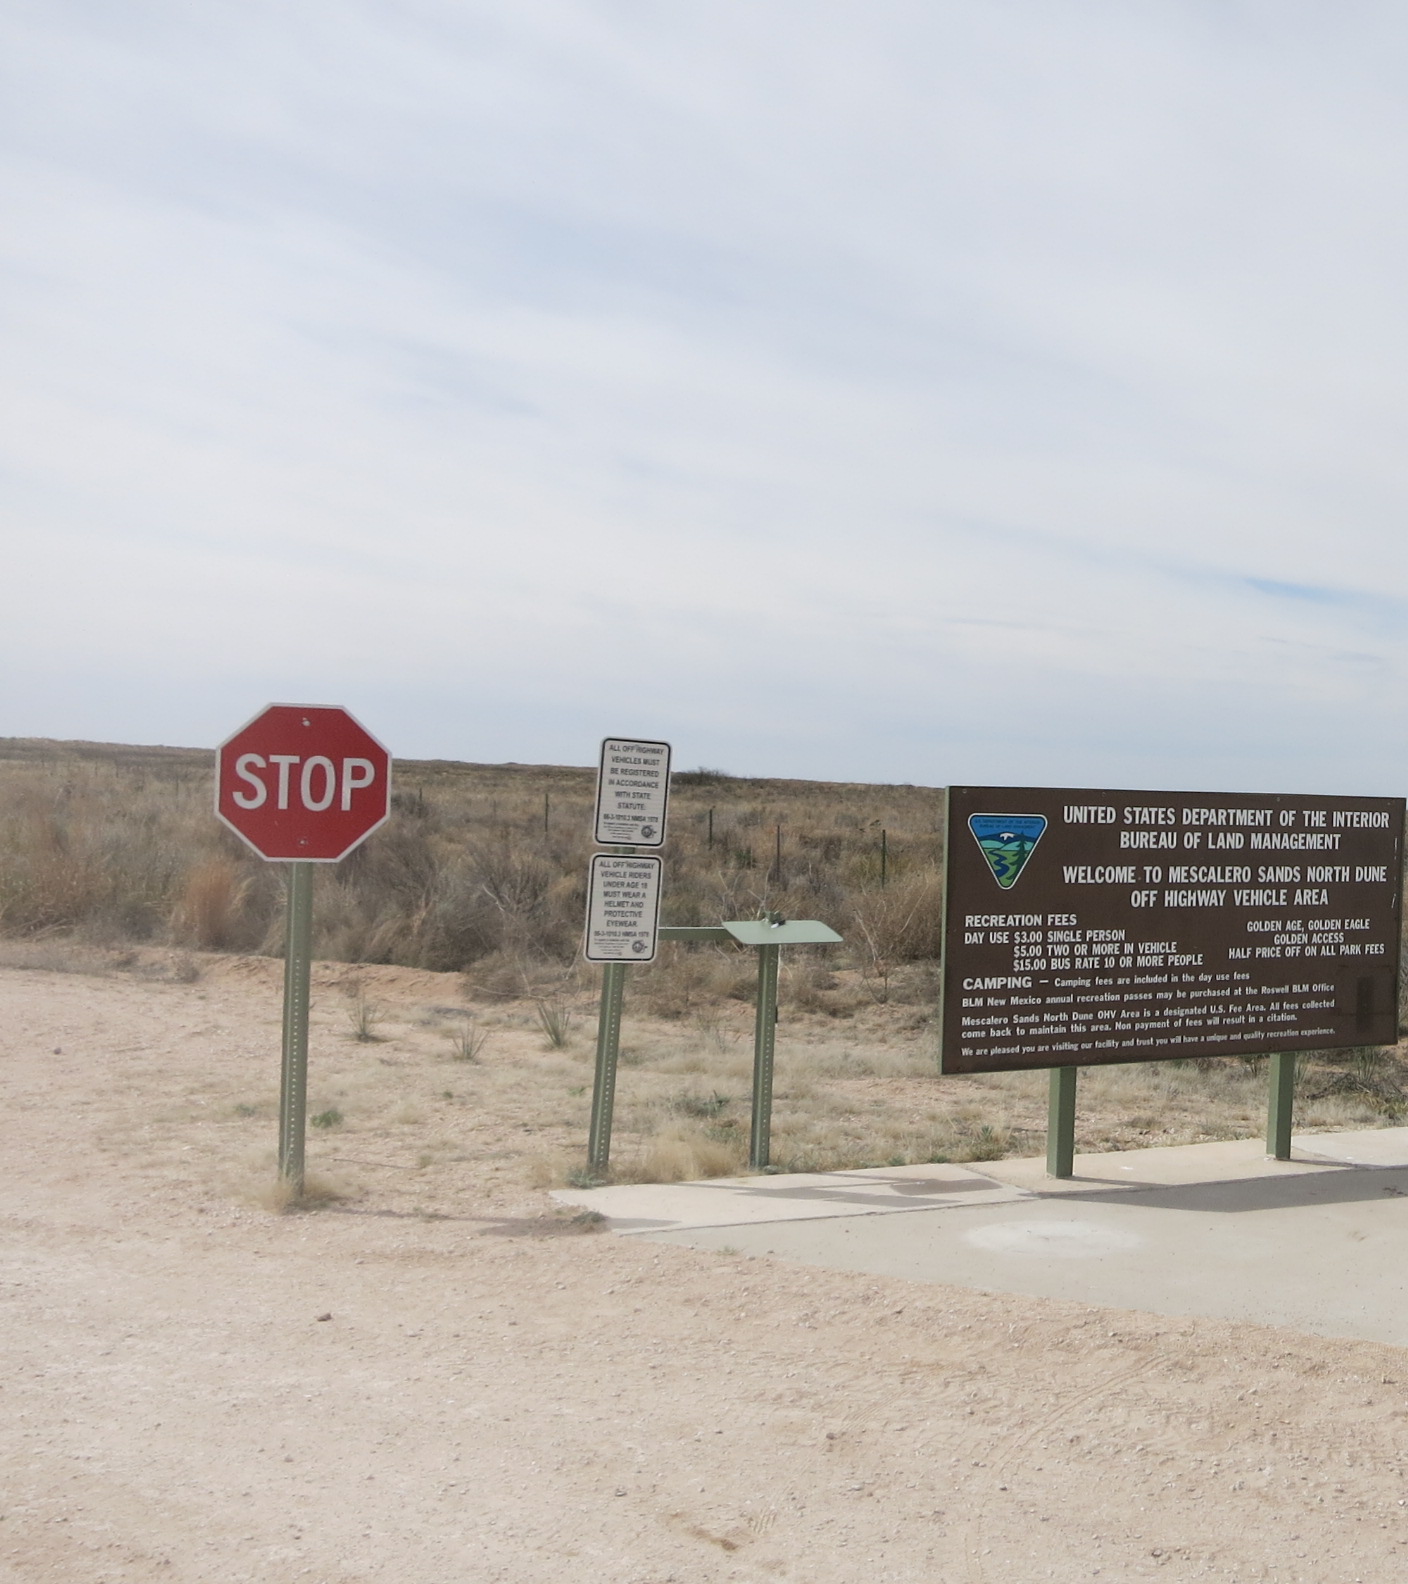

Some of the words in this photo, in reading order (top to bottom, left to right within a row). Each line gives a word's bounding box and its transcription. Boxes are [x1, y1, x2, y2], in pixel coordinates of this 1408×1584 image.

[611, 755, 642, 765] VEHICLES
[642, 758, 660, 766] MUST
[610, 767, 619, 775] BE
[620, 768, 660, 778] REGISTERED
[232, 752, 375, 812] STOP
[615, 779, 659, 789] ACCORDANCE
[615, 790, 631, 799] WITH
[631, 791, 651, 800] STATE
[1063, 806, 1116, 823] UNITED
[1123, 807, 1175, 824] STATES
[1182, 808, 1273, 826] DEPARTMENT
[1279, 810, 1296, 826] OF
[1302, 810, 1326, 826] THE
[1332, 811, 1389, 827] INTERIOR
[1120, 832, 1176, 848] BUREAU
[1183, 832, 1201, 848] OF
[1208, 832, 1244, 848] LAND
[1250, 832, 1341, 849] MANAGEMENT
[601, 870, 627, 879] VEHICLE
[628, 871, 652, 880] RIDERS
[1062, 866, 1135, 883] WELCOME
[1143, 866, 1161, 883] TO
[1168, 866, 1251, 882] MESCALERO
[1257, 866, 1300, 882] SANDS
[1306, 866, 1349, 882] NORTH
[1355, 866, 1386, 881] DUNE
[603, 881, 625, 889] UNDER
[625, 881, 639, 889] AGE
[603, 890, 621, 898] MUST
[622, 891, 641, 899] WEAR
[1130, 890, 1157, 907] OFF
[1164, 890, 1225, 906] HIGHWAY
[1233, 889, 1287, 905] VEHICLE
[1293, 889, 1328, 905] AREA
[604, 900, 629, 908] HELMET
[630, 901, 644, 909] AND
[603, 910, 642, 919] PROTECTIVE
[965, 914, 1041, 927] RECREATION
[1047, 914, 1076, 925] FEES
[1246, 920, 1281, 931] GOLDEN
[1285, 919, 1304, 931] AGE,
[1307, 919, 1341, 930] GOLDEN
[1344, 918, 1369, 929] EAGLE
[964, 931, 984, 944] DAY
[989, 931, 1009, 943] USE
[1014, 930, 1042, 943] $3.00
[1047, 930, 1081, 942] SINGLE
[1086, 929, 1125, 941] PERSON
[1273, 933, 1308, 944] GOLDEN
[1311, 932, 1344, 943] ACCESS
[1013, 944, 1042, 957] $5.00
[1046, 944, 1069, 956] TWO
[1073, 943, 1087, 955] OR
[1091, 942, 1120, 955] MORE
[1124, 942, 1133, 954] IN
[1138, 941, 1176, 953] VEHICLE
[1228, 947, 1251, 958] HALF
[1255, 946, 1281, 958] PRICE
[1284, 945, 1301, 957] OFF
[1304, 945, 1316, 956] ON
[1320, 944, 1335, 956] ALL
[1339, 944, 1361, 955] PARK
[1364, 943, 1384, 954] FEES
[1013, 958, 1046, 971] $15.00
[1050, 958, 1070, 969] BUS
[1074, 957, 1099, 969] RATE
[1104, 956, 1115, 968] 10
[1119, 956, 1132, 967] OR
[1136, 955, 1163, 967] MORE
[1167, 954, 1203, 966] PEOPLE
[962, 976, 1031, 989] CAMPING
[1054, 976, 1090, 988] Camping
[1095, 976, 1113, 985] fees
[1133, 974, 1167, 983] included
[1170, 973, 1178, 982] in
[1181, 973, 1195, 982] the
[1198, 972, 1212, 983] day
[1233, 971, 1249, 979] fees
[962, 997, 983, 1007] BLM
[987, 996, 1006, 1006] New
[1010, 995, 1041, 1005] Mexico
[1045, 993, 1073, 1003] annual
[1076, 991, 1120, 1002] recreation
[1123, 992, 1152, 1001] passes
[1156, 991, 1172, 1000] may
[1176, 989, 1186, 998] be
[1189, 987, 1230, 998] purchased
[1233, 986, 1241, 995] at
[1245, 986, 1257, 994] the
[1261, 984, 1289, 994] Roswell
[1292, 984, 1309, 992] BLM
[1312, 983, 1334, 991] Office
[961, 1014, 1008, 1026] Mescalero
[1012, 1013, 1039, 1023] Sands
[1043, 1011, 1068, 1022] North
[1072, 1010, 1093, 1020] Dune
[1097, 1009, 1116, 1019] OHV
[1120, 1008, 1139, 1018] Area
[1143, 1007, 1150, 1017] is
[1163, 1005, 1206, 1017] designated
[1210, 1004, 1225, 1013] U.S.
[1228, 1003, 1242, 1013] Fee
[1245, 1002, 1266, 1011] Area.
[1269, 1001, 1279, 1010] All
[1282, 1000, 1298, 1010] fees
[1302, 999, 1334, 1009] collected
[961, 1030, 985, 1038] come
[989, 1027, 1011, 1037] back
[1016, 1026, 1025, 1035] to
[1029, 1024, 1066, 1034] maintain
[1070, 1023, 1086, 1032] this
[1090, 1023, 1111, 1031] area.
[1115, 1021, 1131, 1030] Non
[1134, 1019, 1169, 1030] payment
[1173, 1018, 1181, 1027] of
[1185, 1017, 1202, 1026] fees
[1206, 1017, 1219, 1025] will
[1222, 1015, 1245, 1024] result
[1248, 1015, 1255, 1023] in
[1266, 1013, 1297, 1022] citation.
[961, 1047, 973, 1056] We
[990, 1044, 1019, 1055] pleased
[1021, 1045, 1035, 1054] you
[1051, 1041, 1078, 1052] visiting
[1094, 1038, 1119, 1049] facility
[1121, 1037, 1134, 1046] and
[1136, 1036, 1153, 1046] trust
[1155, 1038, 1168, 1046] you
[1169, 1035, 1181, 1043] will
[1182, 1034, 1198, 1042] have
[1206, 1032, 1227, 1042] unique
[1229, 1032, 1241, 1040] and
[1243, 1030, 1265, 1040] quality
[1266, 1028, 1299, 1037] recreation
